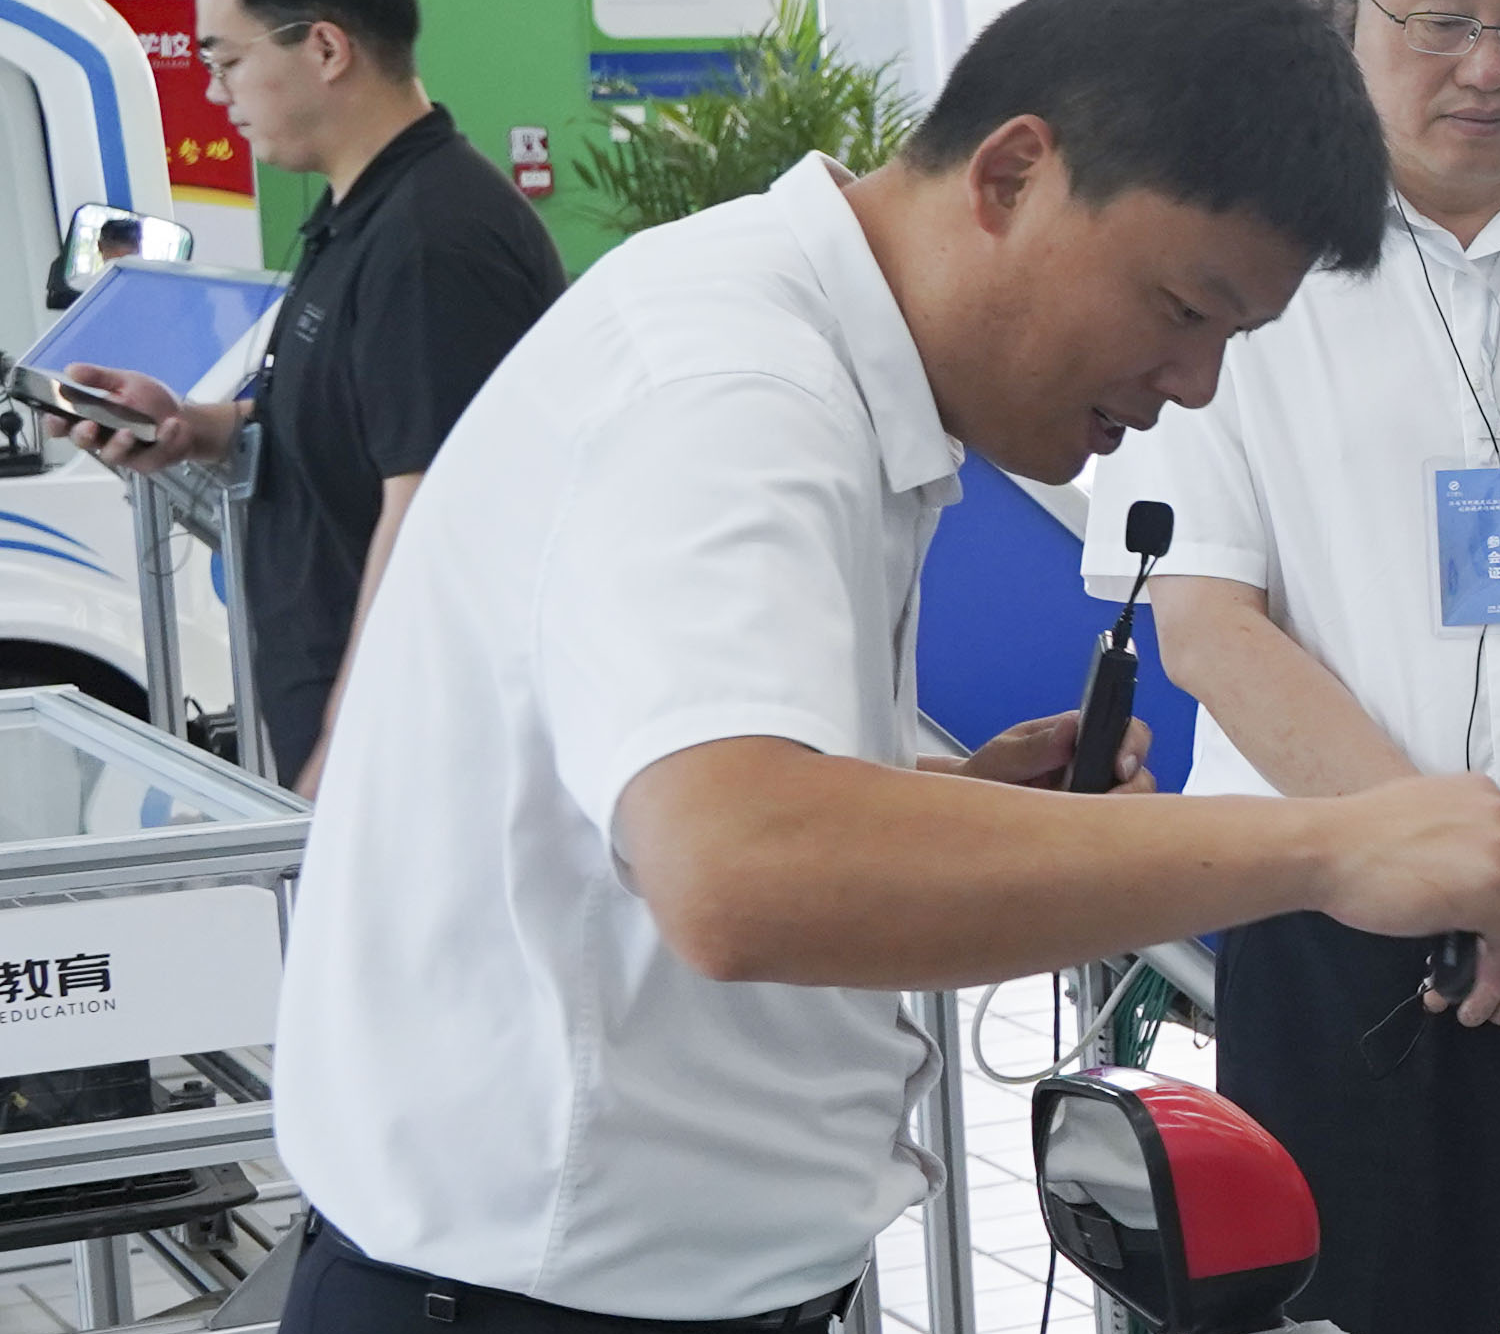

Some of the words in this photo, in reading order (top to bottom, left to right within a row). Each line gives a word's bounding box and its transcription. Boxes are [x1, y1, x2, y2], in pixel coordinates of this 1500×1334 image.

[165, 137, 234, 166] 参观
[0, 953, 112, 1004] 教育
[0, 998, 117, 1024] EDUCATION
